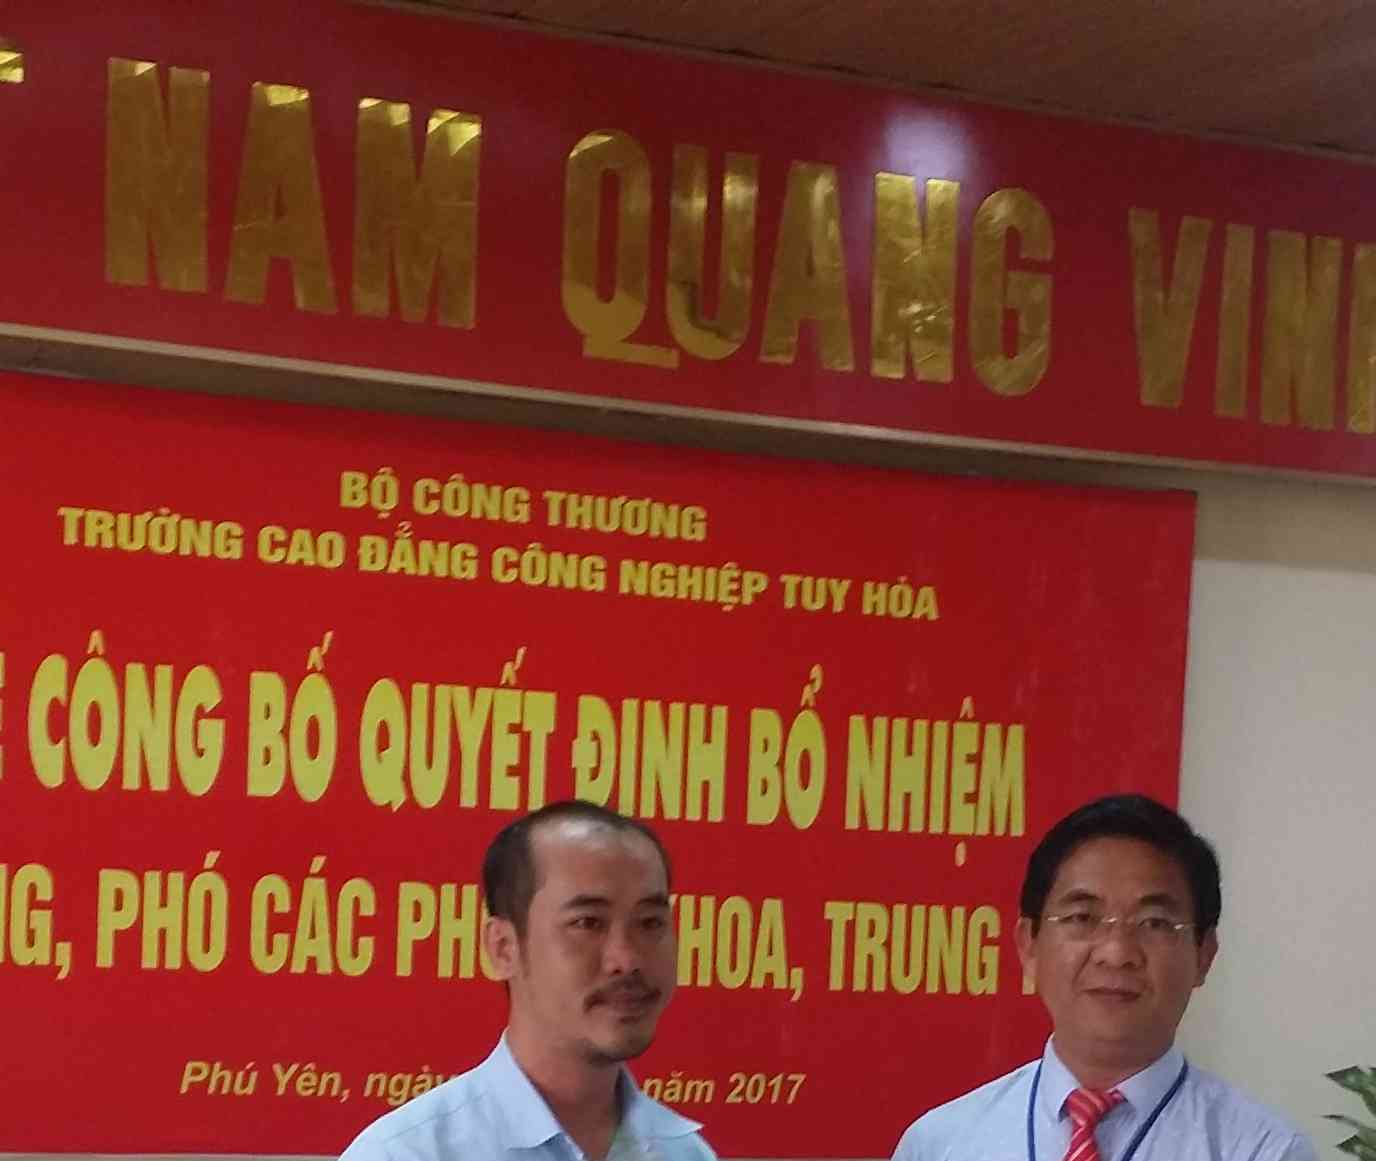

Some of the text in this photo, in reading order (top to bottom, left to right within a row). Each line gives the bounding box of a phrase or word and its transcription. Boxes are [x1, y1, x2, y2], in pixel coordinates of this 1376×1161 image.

[105, 57, 483, 329] NAM
[560, 128, 1055, 397] QUANG
[57, 507, 941, 621] TRƯỜNG CAO ĐẲNG CÔNG NGHIỆP TUY HÒA
[340, 467, 708, 542] BỘ CÔNG THƯƠNG
[29, 633, 225, 797] CÔNG
[248, 634, 338, 802] BỐ
[361, 651, 557, 813] QUYẾT
[748, 667, 827, 830] BỔ
[847, 700, 1025, 865] NHIỆM
[98, 854, 229, 972] PHÓ
[252, 858, 376, 977] CÁC
[397, 882, 496, 981] PH
[669, 894, 805, 1000] HOA,
[826, 903, 1001, 995] TRUNG
[179, 1061, 808, 1106] Phú Yên, ngà năm 2017
